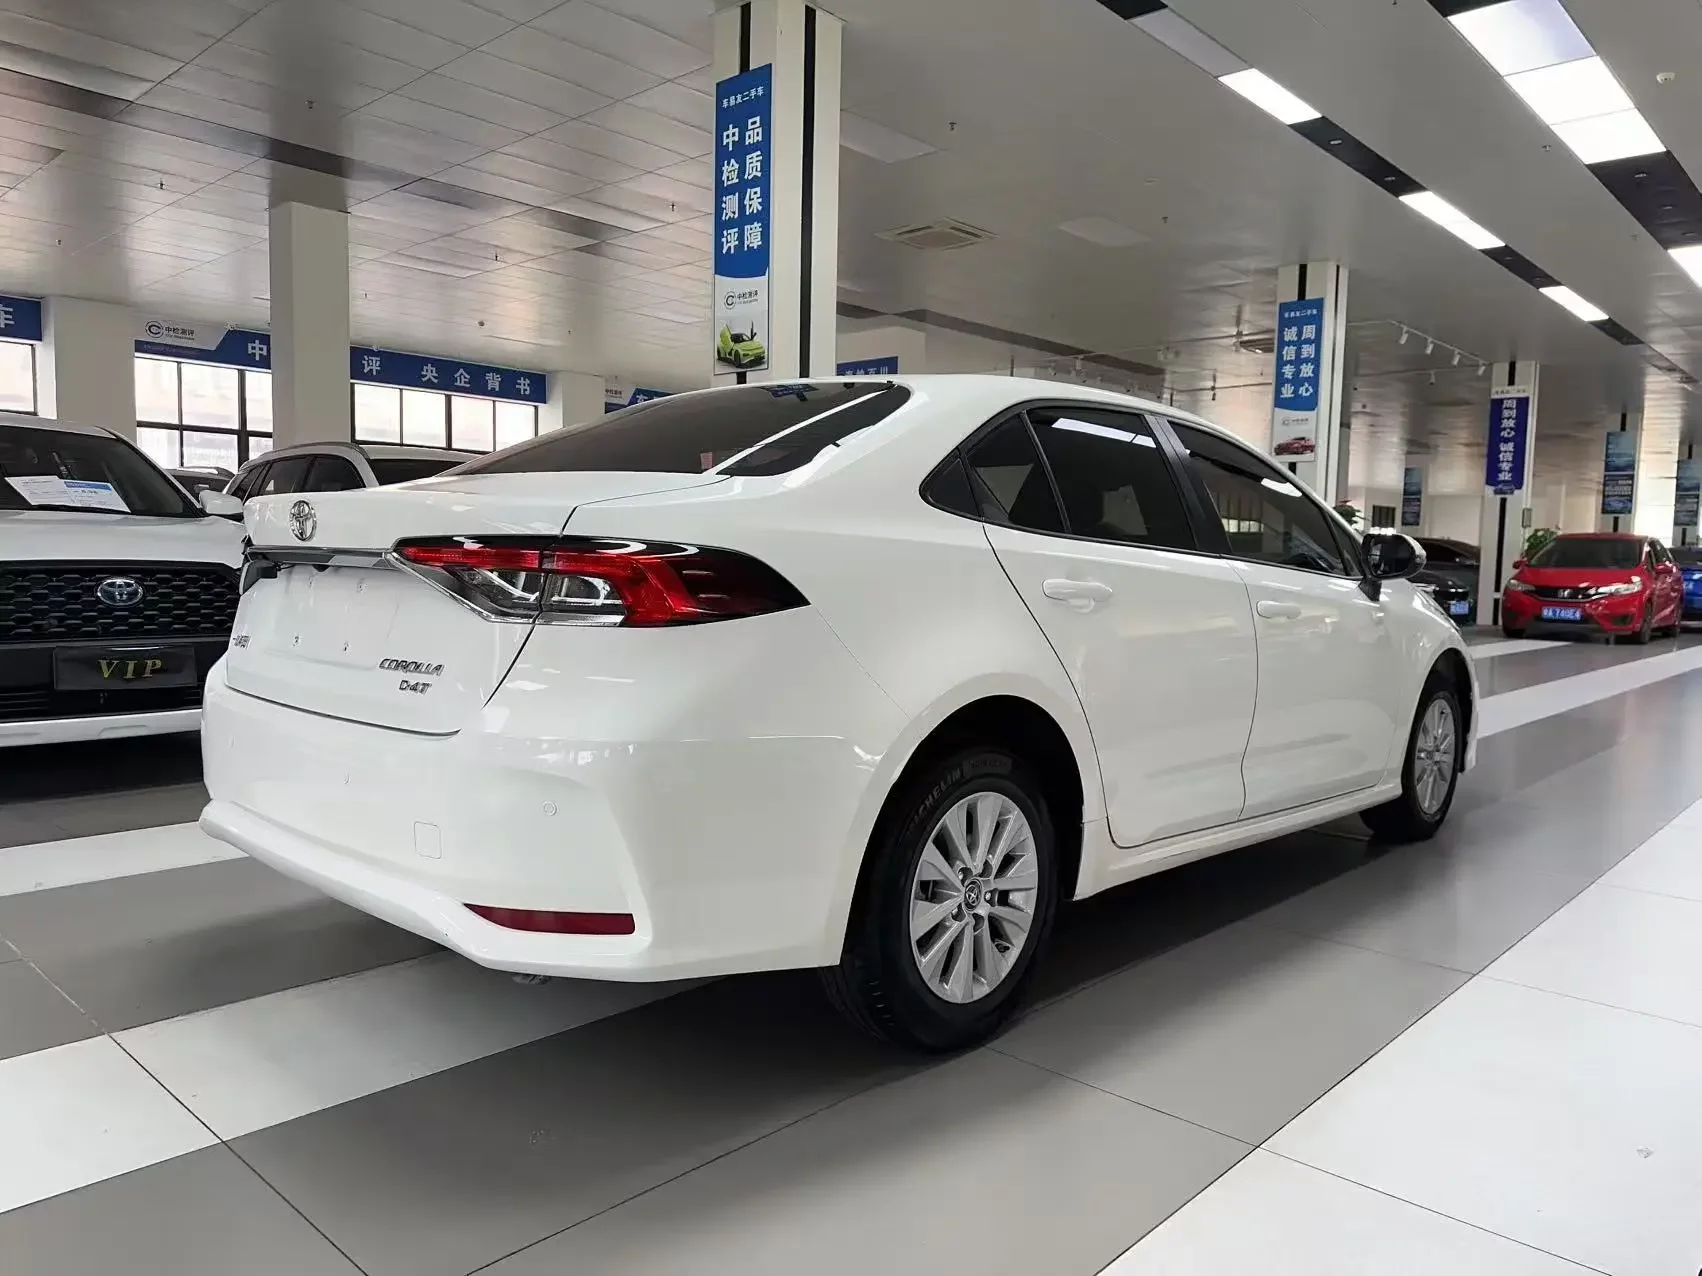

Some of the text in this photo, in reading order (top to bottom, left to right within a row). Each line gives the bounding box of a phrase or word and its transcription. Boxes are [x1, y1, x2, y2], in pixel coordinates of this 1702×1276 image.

[721, 123, 740, 255] 中检测评
[743, 115, 763, 251] 品质保障
[1280, 326, 1299, 398] 诚信专业
[1299, 324, 1316, 397] 周到放心
[97, 658, 162, 680] VIP
[378, 658, 445, 677] COROLLA
